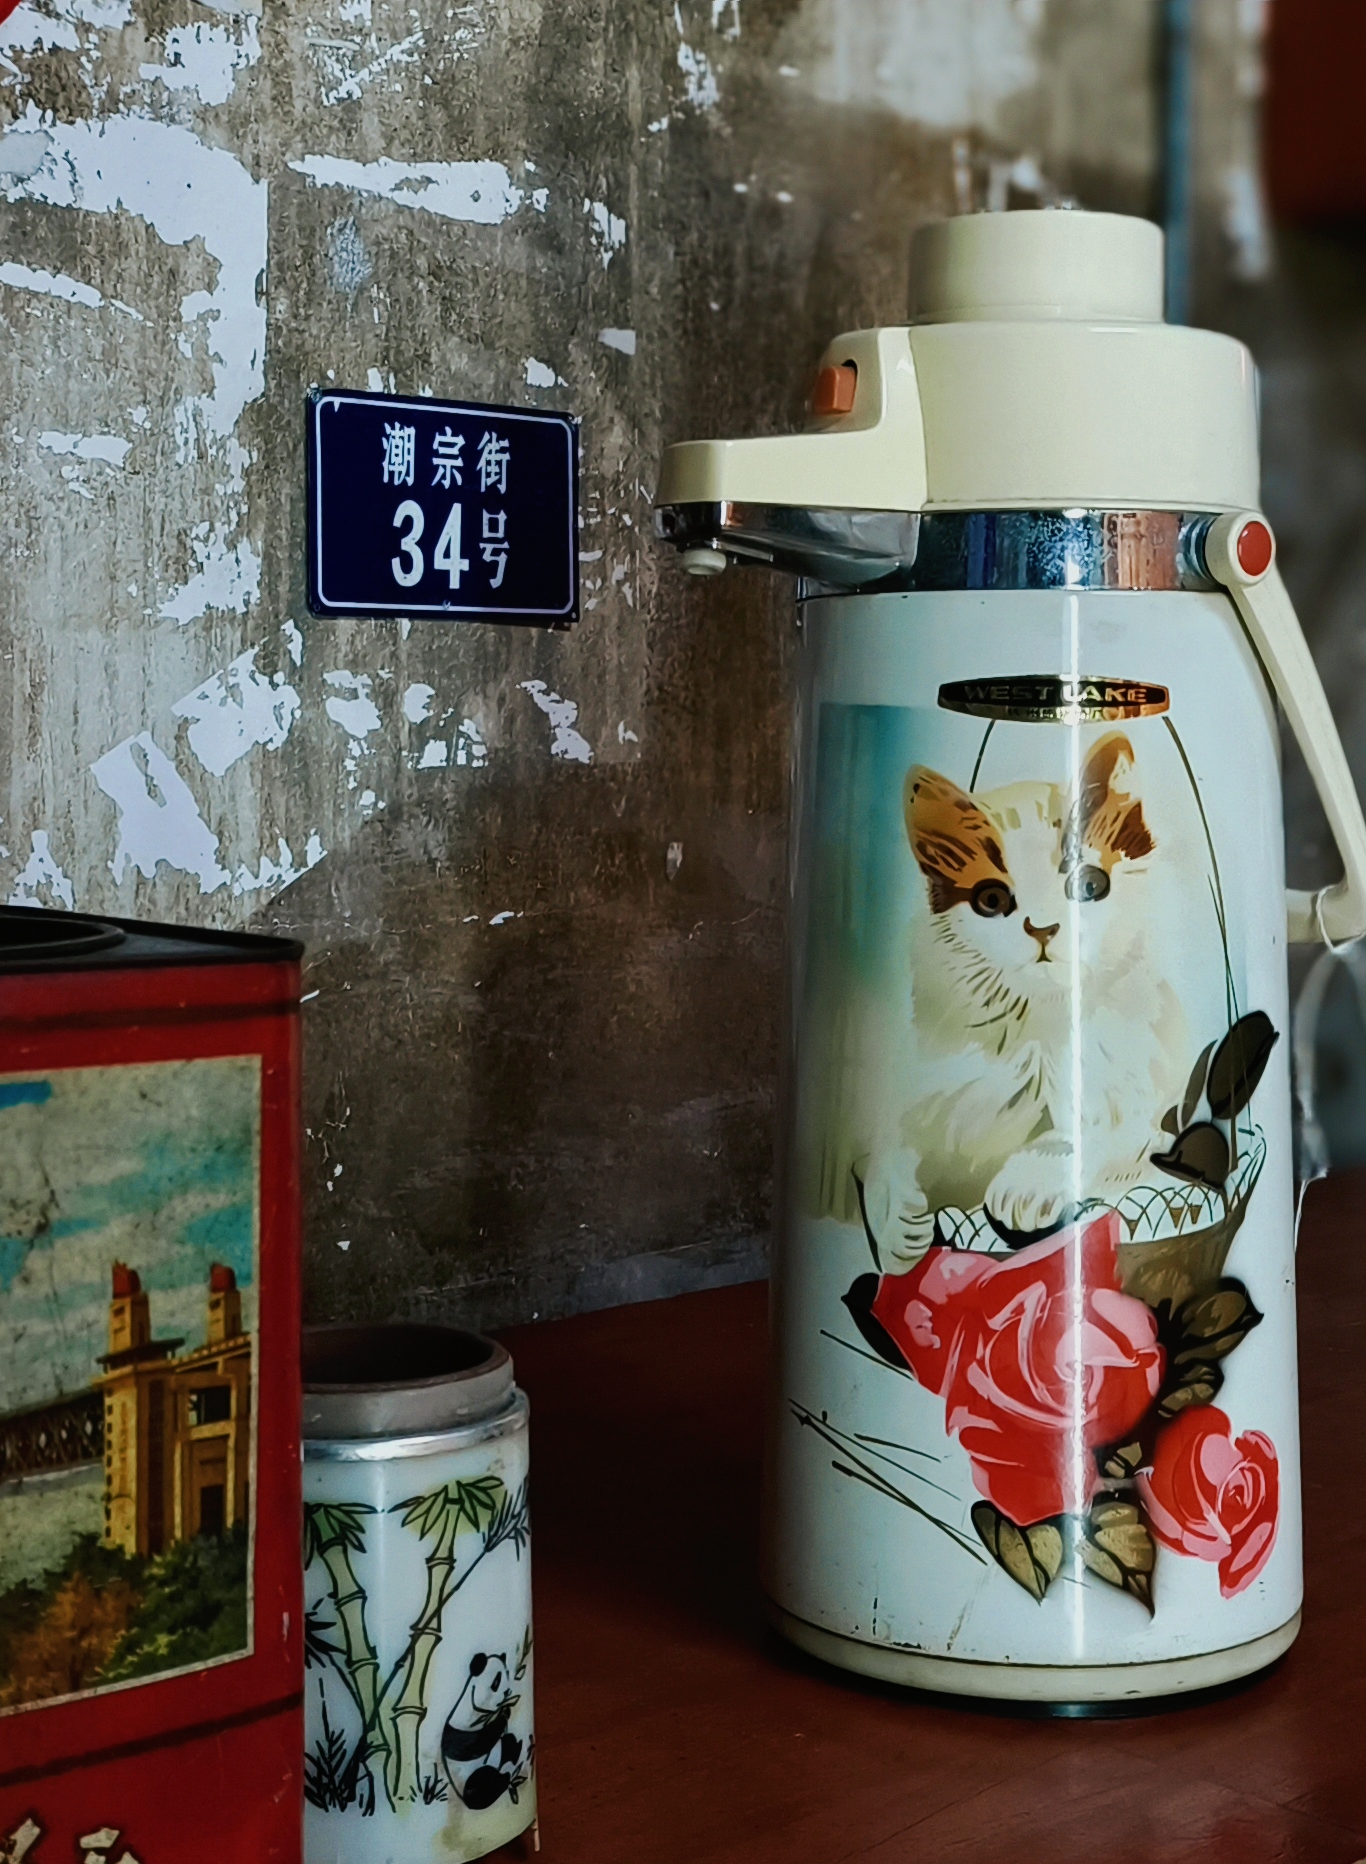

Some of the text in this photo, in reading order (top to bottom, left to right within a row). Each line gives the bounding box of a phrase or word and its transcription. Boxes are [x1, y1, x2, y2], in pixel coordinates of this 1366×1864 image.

[382, 421, 511, 494] 潮宗街
[963, 685, 1147, 703] WEST LAKE
